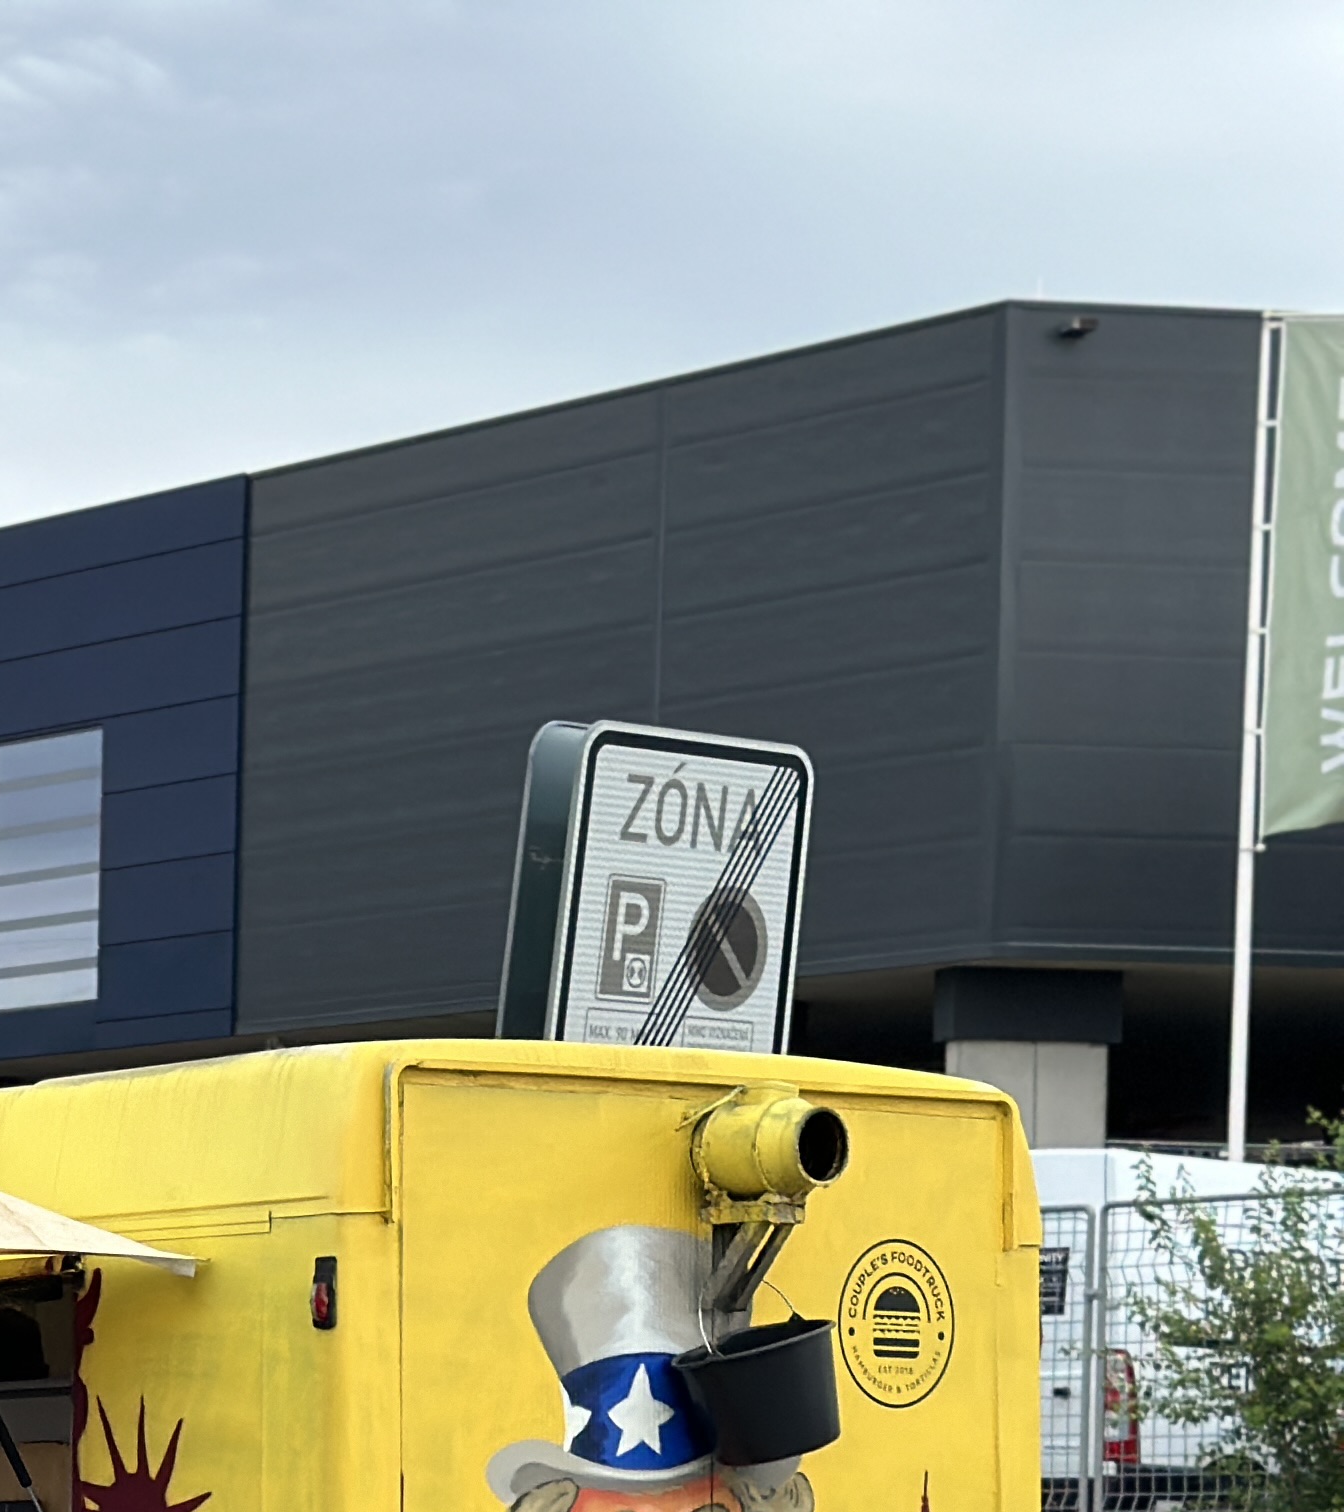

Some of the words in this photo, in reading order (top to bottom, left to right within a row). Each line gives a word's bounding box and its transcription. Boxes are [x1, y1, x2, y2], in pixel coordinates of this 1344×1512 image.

[619, 762, 762, 852] ZÓNA
[612, 892, 650, 961] P
[848, 1253, 889, 1319] COUPLE'S
[890, 1251, 946, 1322] FOODTRUCK
